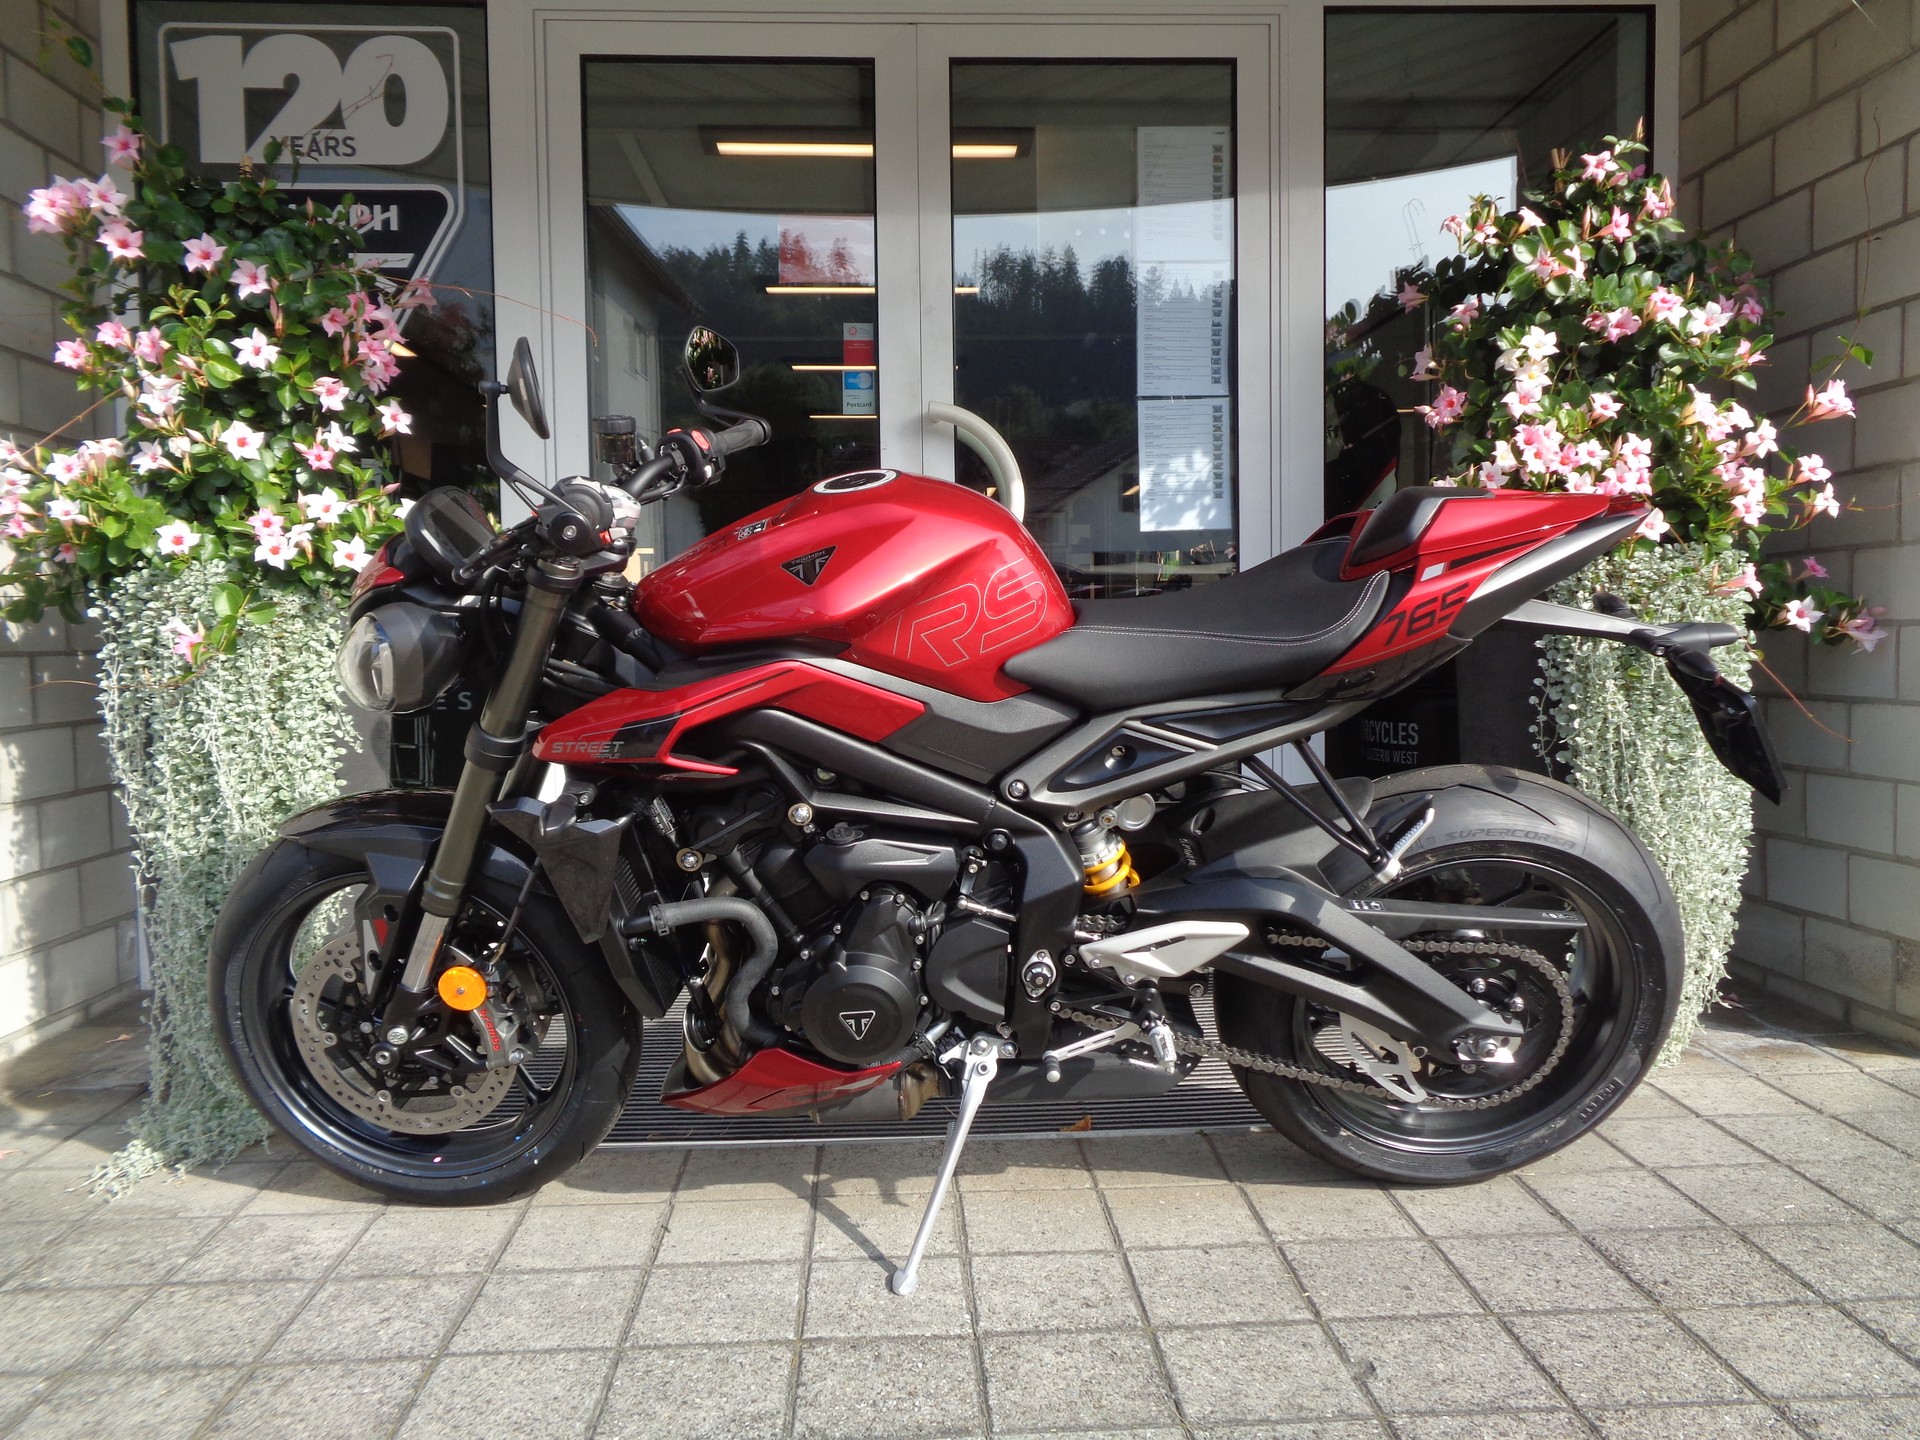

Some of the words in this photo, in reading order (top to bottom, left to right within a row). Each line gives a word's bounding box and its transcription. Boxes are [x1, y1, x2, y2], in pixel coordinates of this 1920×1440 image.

[170, 34, 449, 165] 120
[791, 550, 826, 565] TRIUMPH
[893, 558, 1048, 667] RS
[1383, 582, 1470, 646] 765
[551, 741, 625, 753] STREET
[1392, 750, 1419, 765] WEST
[1445, 827, 1577, 851] SUPERCORSA
[479, 1008, 502, 1052] brembo
